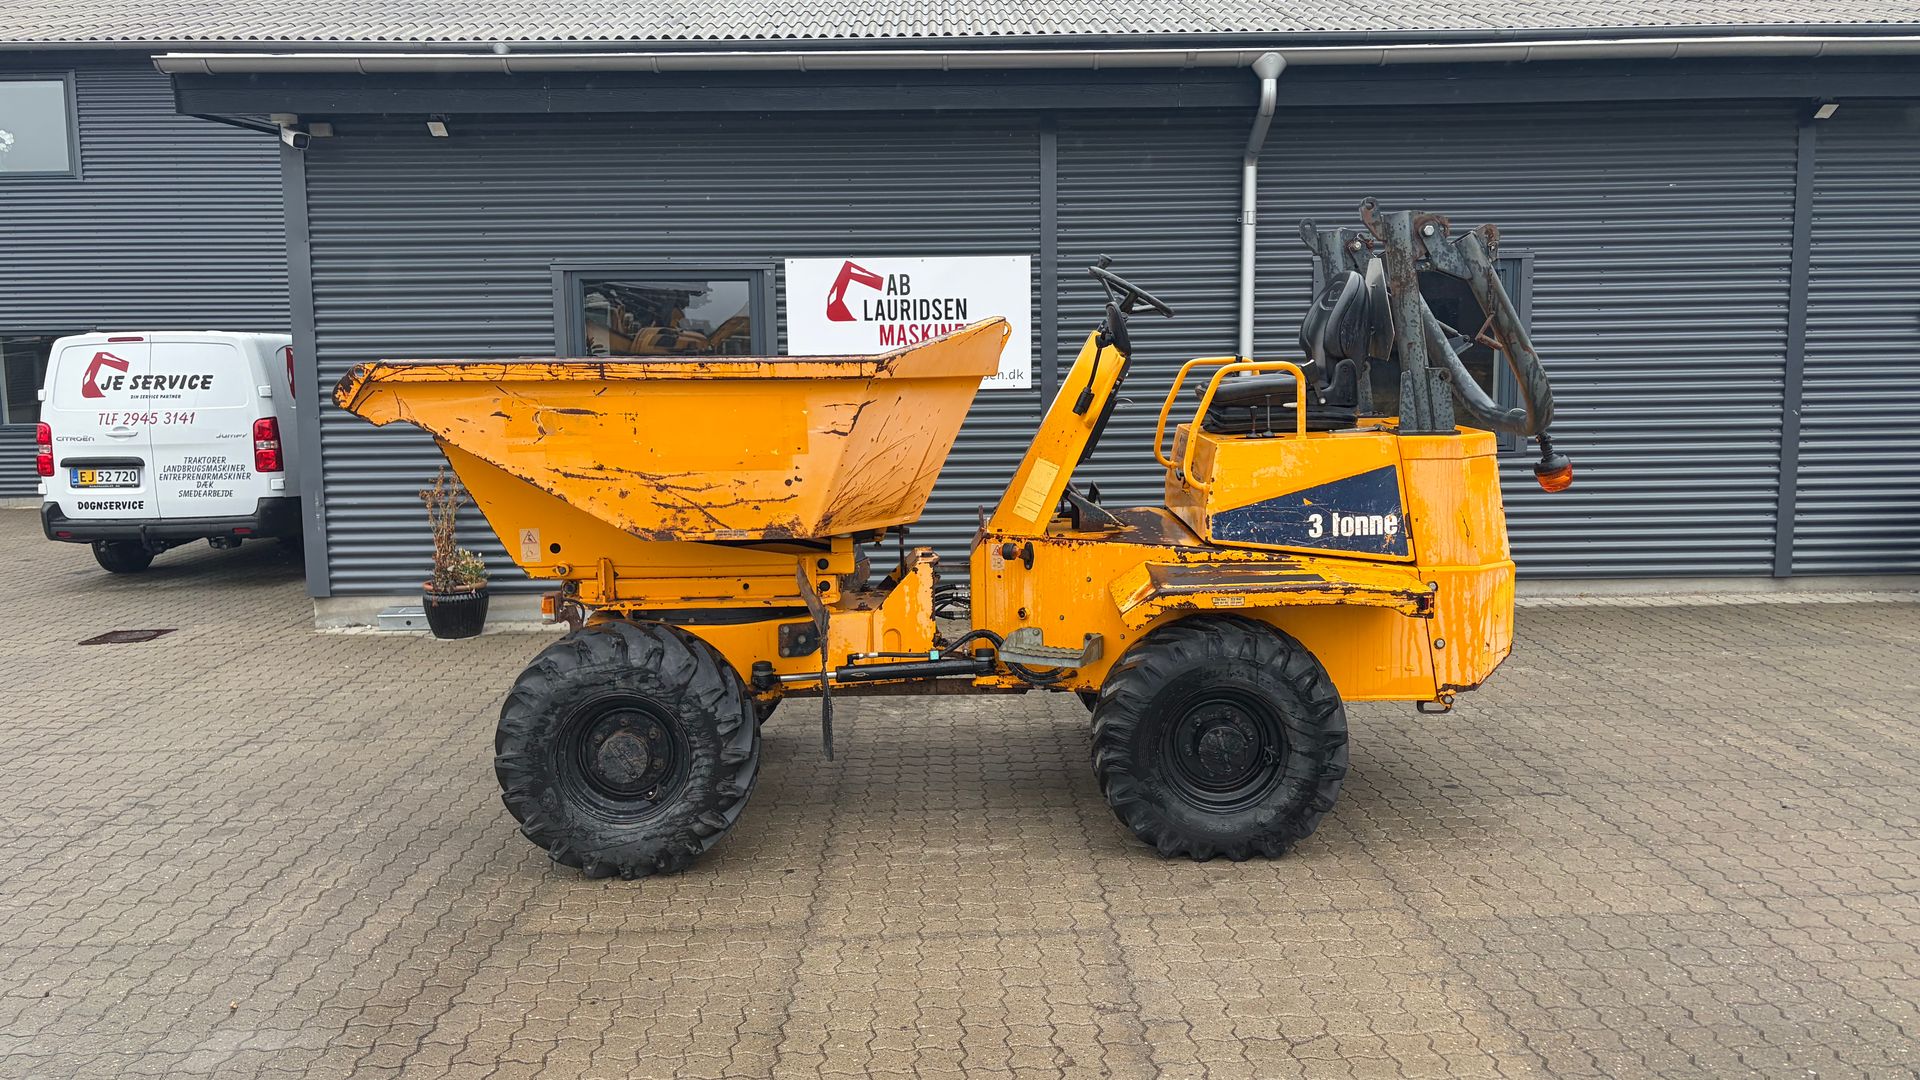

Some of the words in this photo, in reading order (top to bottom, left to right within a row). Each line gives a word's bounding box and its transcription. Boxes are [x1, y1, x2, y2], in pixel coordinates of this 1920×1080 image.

[886, 273, 911, 296] AB
[863, 298, 967, 322] LAURIDSEN
[101, 375, 125, 391] JE
[129, 374, 214, 391] SERVICE
[99, 413, 119, 426] TLF
[122, 411, 158, 427] 2945
[163, 411, 196, 425] 3141
[184, 456, 227, 465] TRAKTORER
[163, 464, 246, 473] LANDBRUGSMASKINER
[80, 471, 95, 483] EJ
[97, 471, 112, 483] 52
[114, 470, 137, 482] 720
[159, 472, 252, 481] ENTREPRENØRMASKINER
[196, 481, 214, 489] DÆK
[178, 489, 234, 498] SMEDEARBEJDE
[1308, 513, 1323, 538] 3
[1332, 512, 1397, 537] tonne
